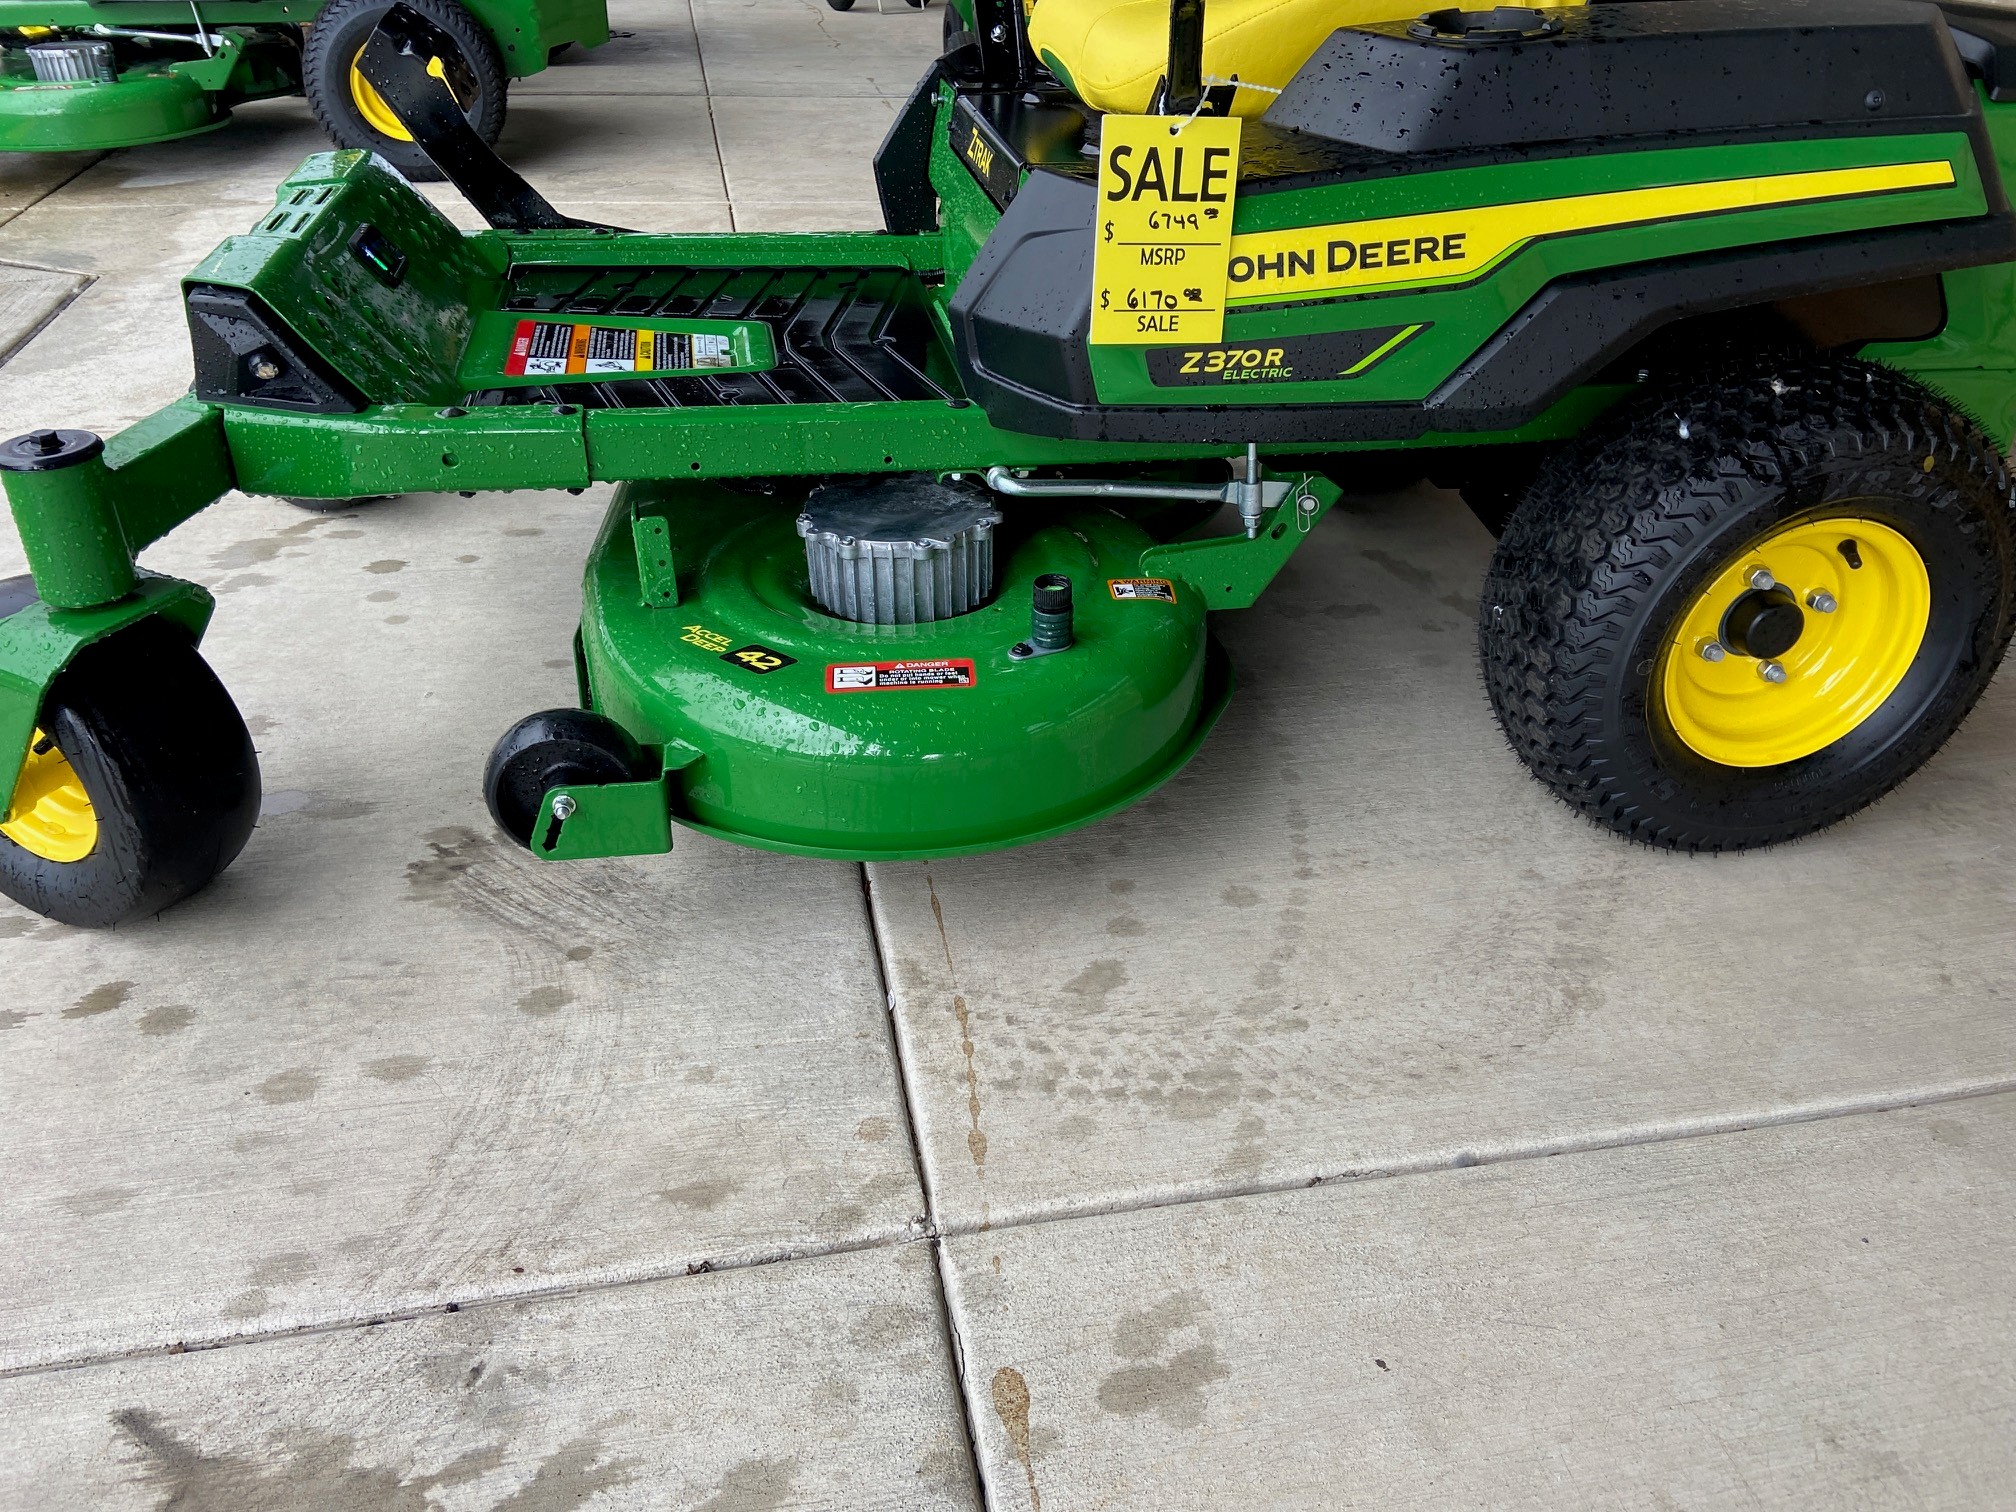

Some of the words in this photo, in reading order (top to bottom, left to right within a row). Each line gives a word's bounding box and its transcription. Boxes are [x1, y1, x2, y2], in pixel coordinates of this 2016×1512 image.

[967, 127, 993, 177] ZTRAK
[1107, 145, 1230, 202] SALE
[1104, 220, 1114, 243] $
[1149, 211, 1199, 230] 6749
[1140, 248, 1186, 265] MSRP
[1228, 249, 1315, 282] OHN
[1327, 233, 1467, 273] DEERE
[1101, 288, 1110, 310] $
[1127, 288, 1178, 309] 6170
[1137, 315, 1179, 332] SALE
[1222, 367, 1294, 380] ELECTRIC
[680, 634, 726, 652] DEEP
[682, 625, 732, 646] ACCEL
[735, 652, 782, 670] 42
